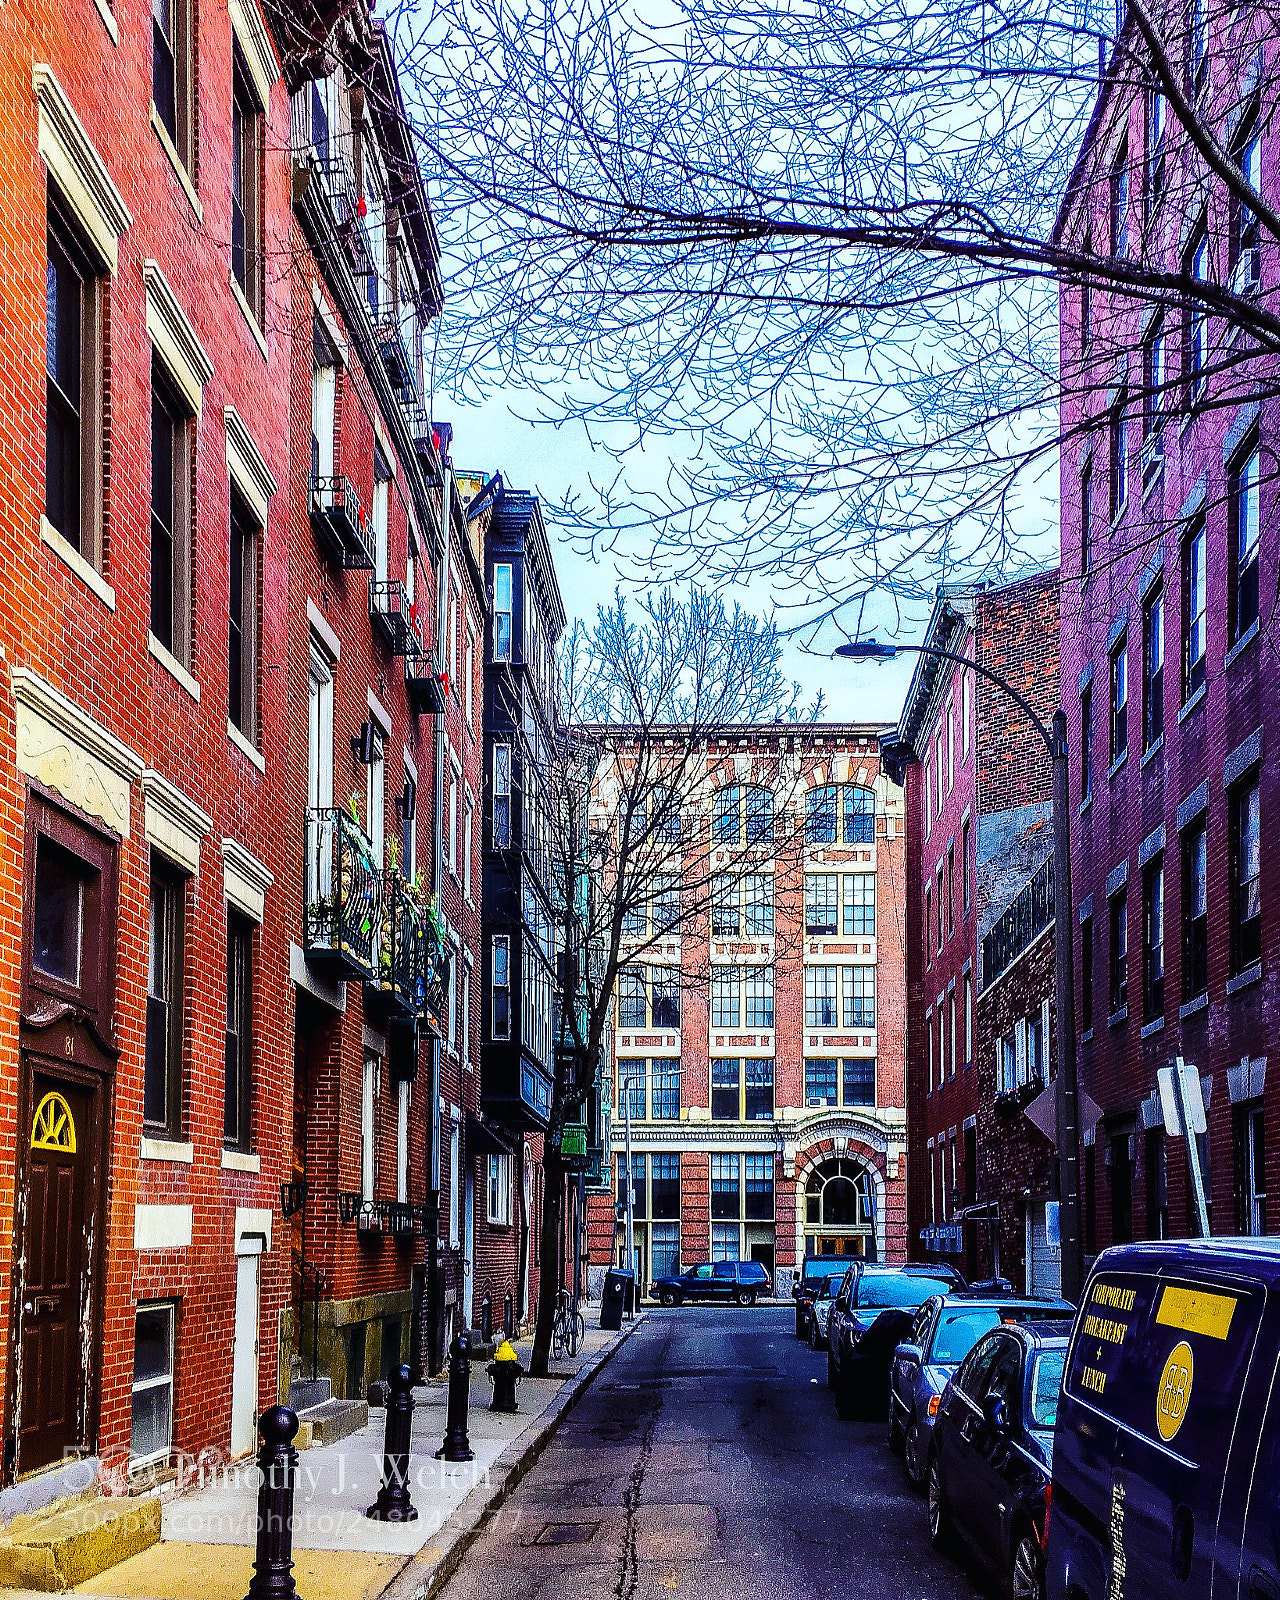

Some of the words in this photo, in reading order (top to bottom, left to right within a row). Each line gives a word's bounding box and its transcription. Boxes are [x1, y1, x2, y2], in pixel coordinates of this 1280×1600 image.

[65, 1036, 74, 1057] 81
[1091, 1283, 1136, 1311] CORPORATE
[1083, 1314, 1128, 1345] BREAKFAST
[1081, 1366, 1107, 1393] LUNCH
